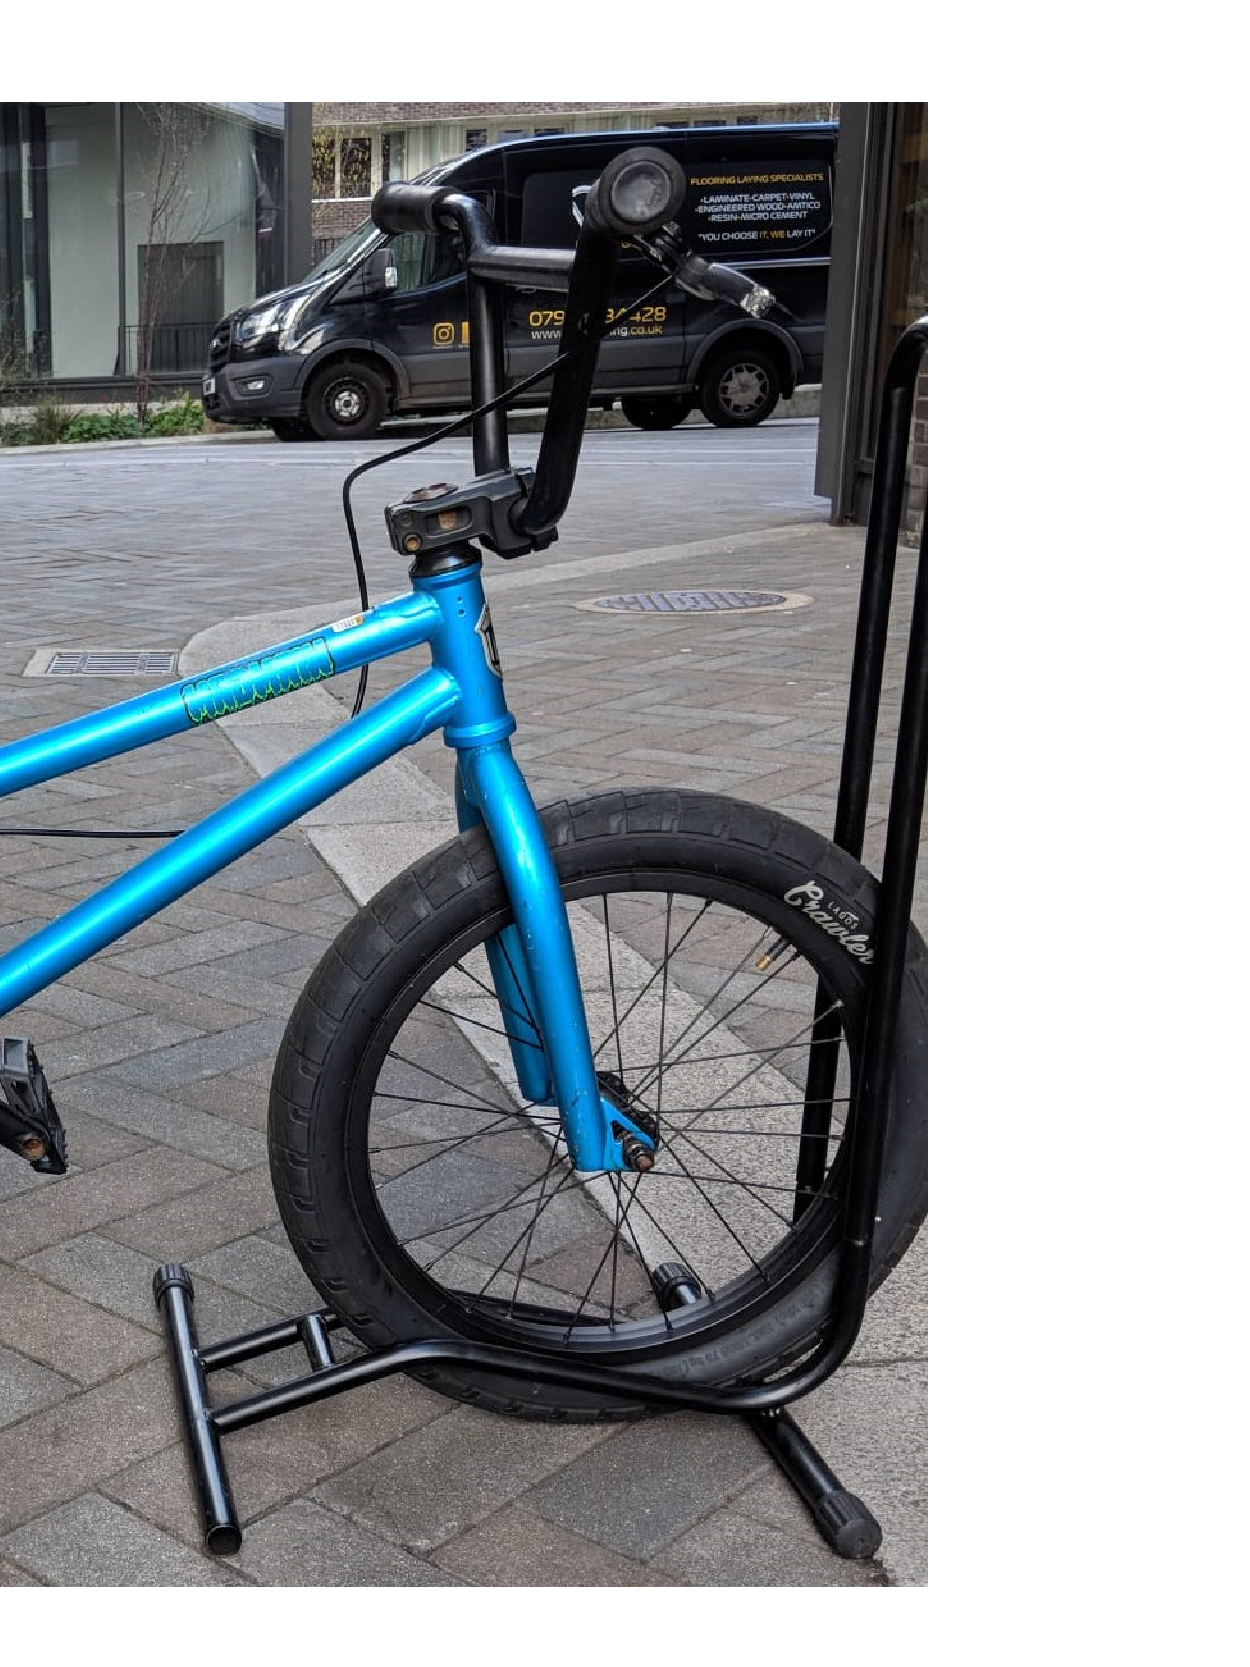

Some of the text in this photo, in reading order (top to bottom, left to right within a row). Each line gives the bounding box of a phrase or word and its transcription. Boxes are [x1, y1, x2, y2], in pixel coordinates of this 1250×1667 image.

[690, 173, 824, 186] FLOORING LAYING SPECIALISTS
[769, 210, 809, 220] CEMENT
[721, 230, 759, 241] CHOOSE
[770, 230, 785, 239] WE
[786, 229, 803, 239] LAY
[783, 879, 875, 965] Crawler
